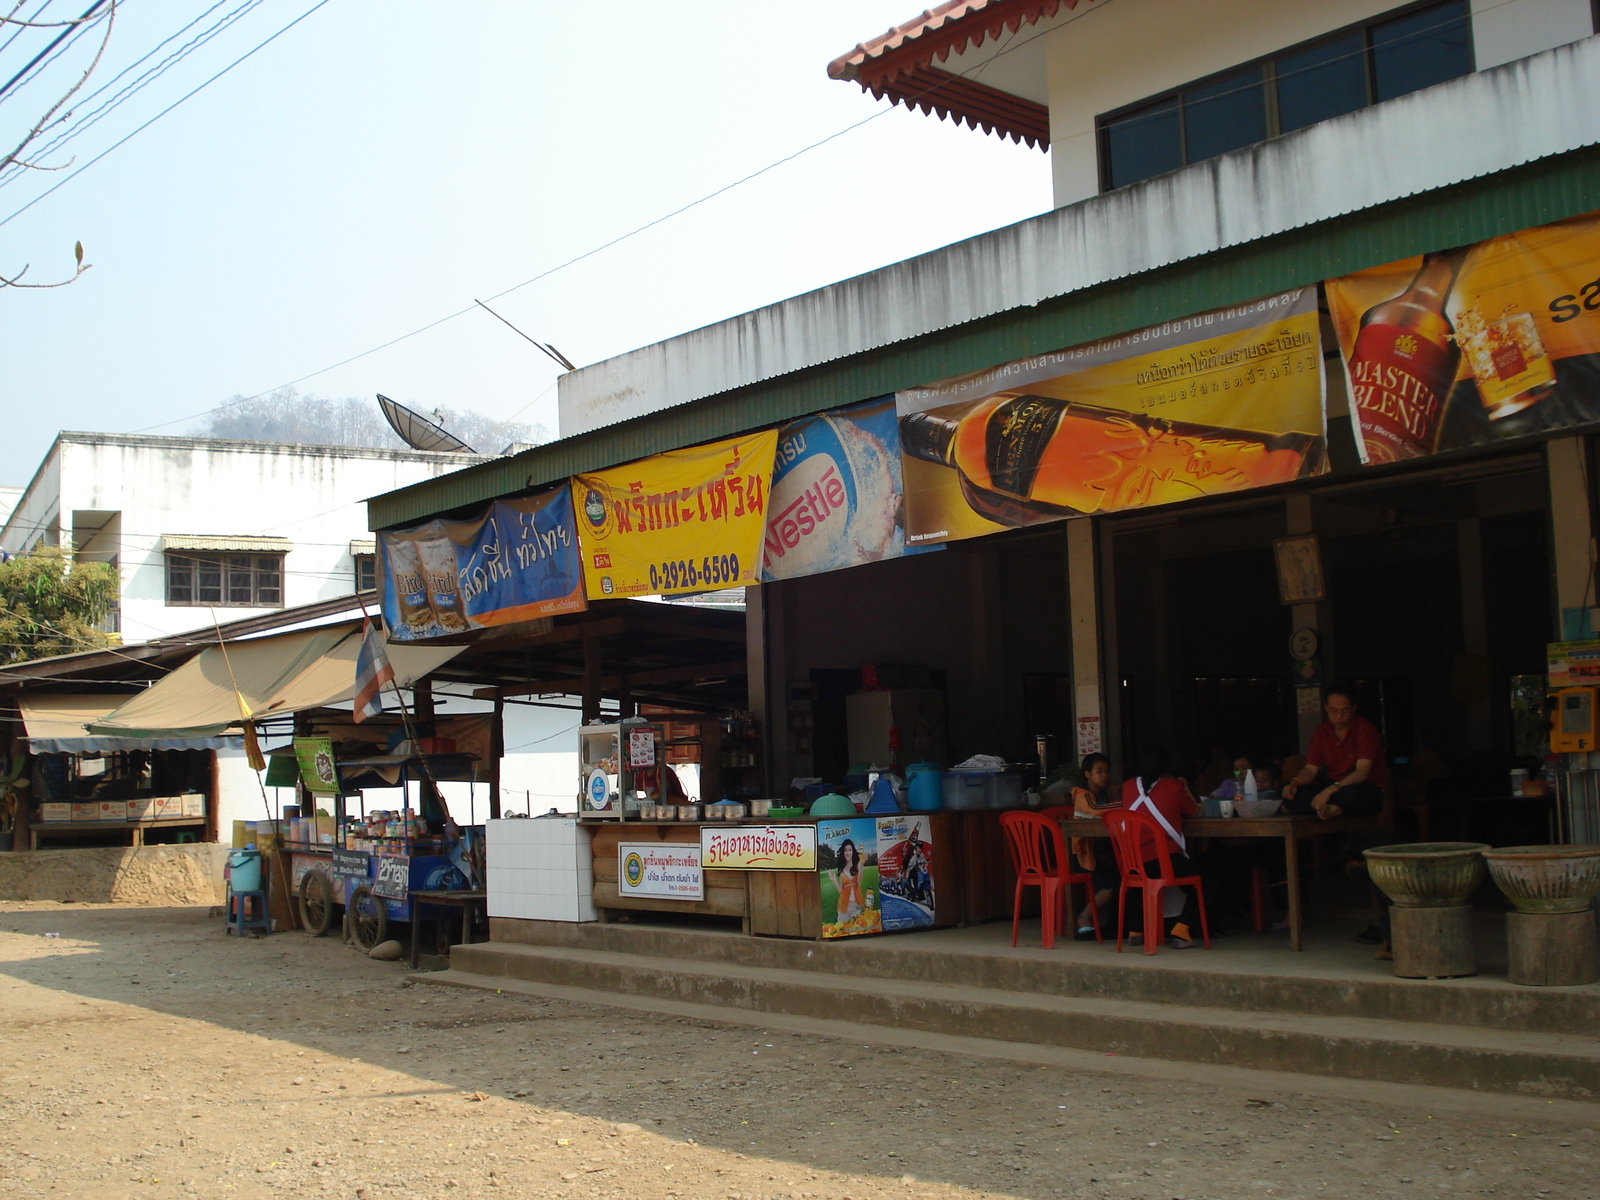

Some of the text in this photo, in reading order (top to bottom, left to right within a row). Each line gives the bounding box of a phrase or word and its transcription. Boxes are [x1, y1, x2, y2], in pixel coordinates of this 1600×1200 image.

[1496, 349, 1518, 363] MASTER
[1500, 356, 1519, 368] BLEND
[1351, 360, 1438, 424] MASTER
[1354, 385, 1427, 440] BLEND
[763, 465, 845, 568] Nestlé
[910, 530, 949, 542] Drink Responsibly
[650, 553, 740, 591] 0-2926-6509
[1569, 666, 1600, 678] SAL
[709, 828, 806, 864] ร้านอาหารน้องอ้อย
